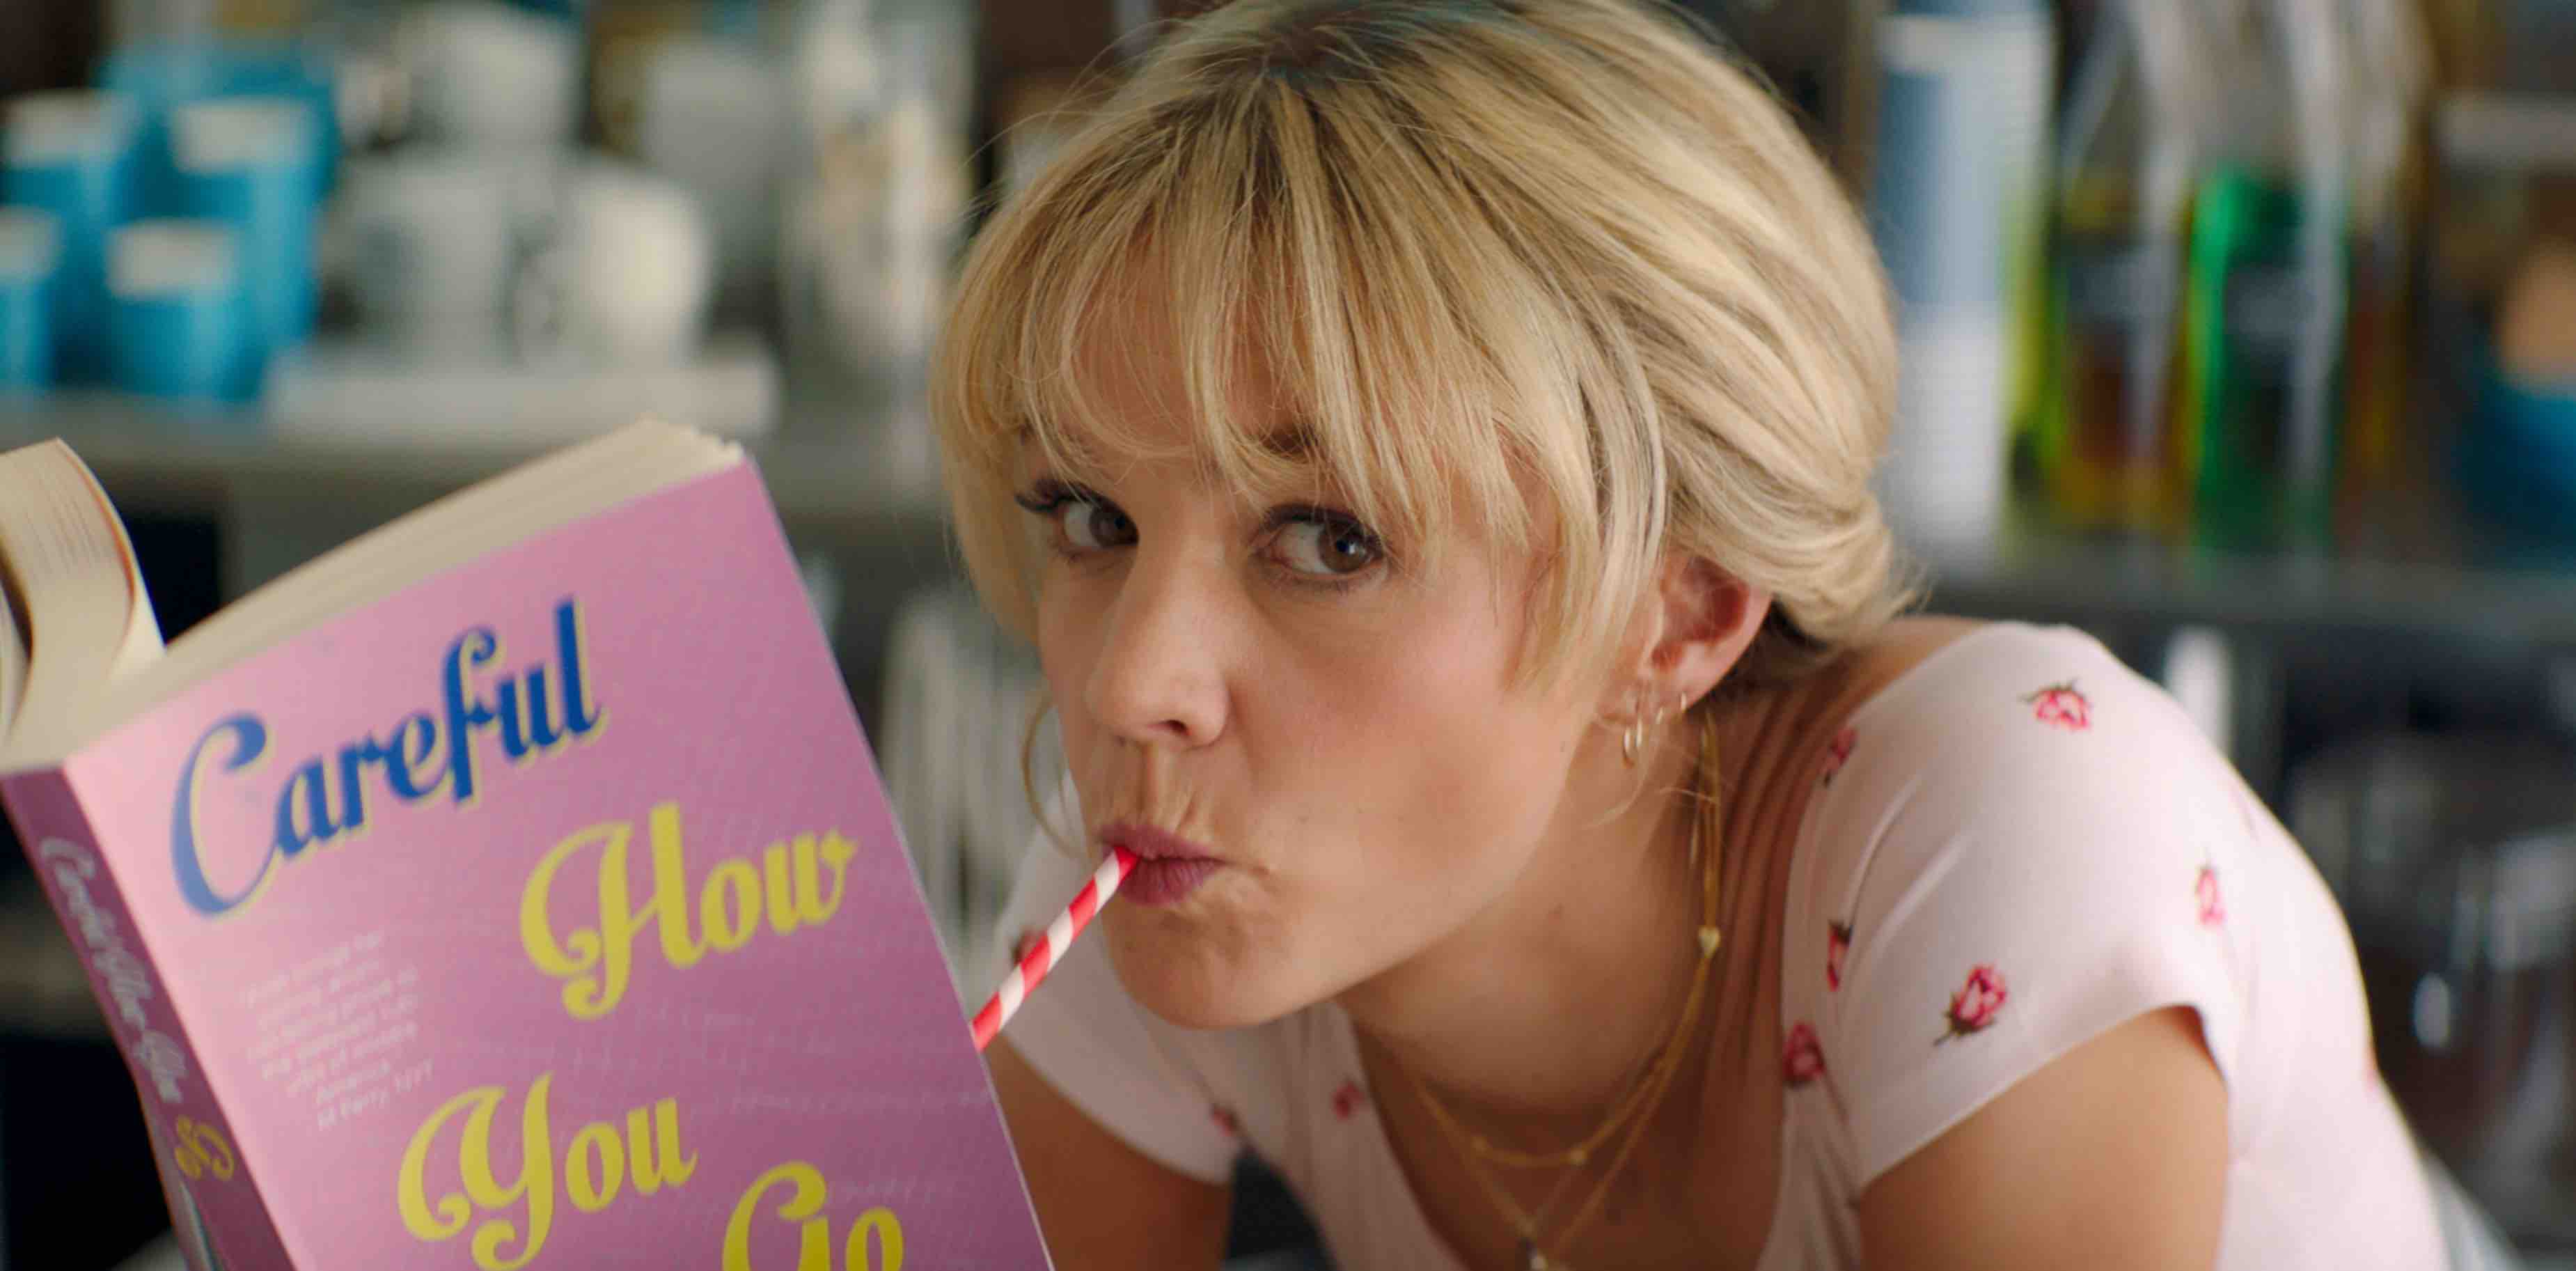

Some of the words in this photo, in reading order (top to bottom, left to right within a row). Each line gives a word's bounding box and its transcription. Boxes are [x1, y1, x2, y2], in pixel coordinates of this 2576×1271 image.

[171, 594, 604, 919] Careful
[519, 801, 858, 1020] How
[398, 1071, 698, 1271] You
[721, 1161, 904, 1271] Go
